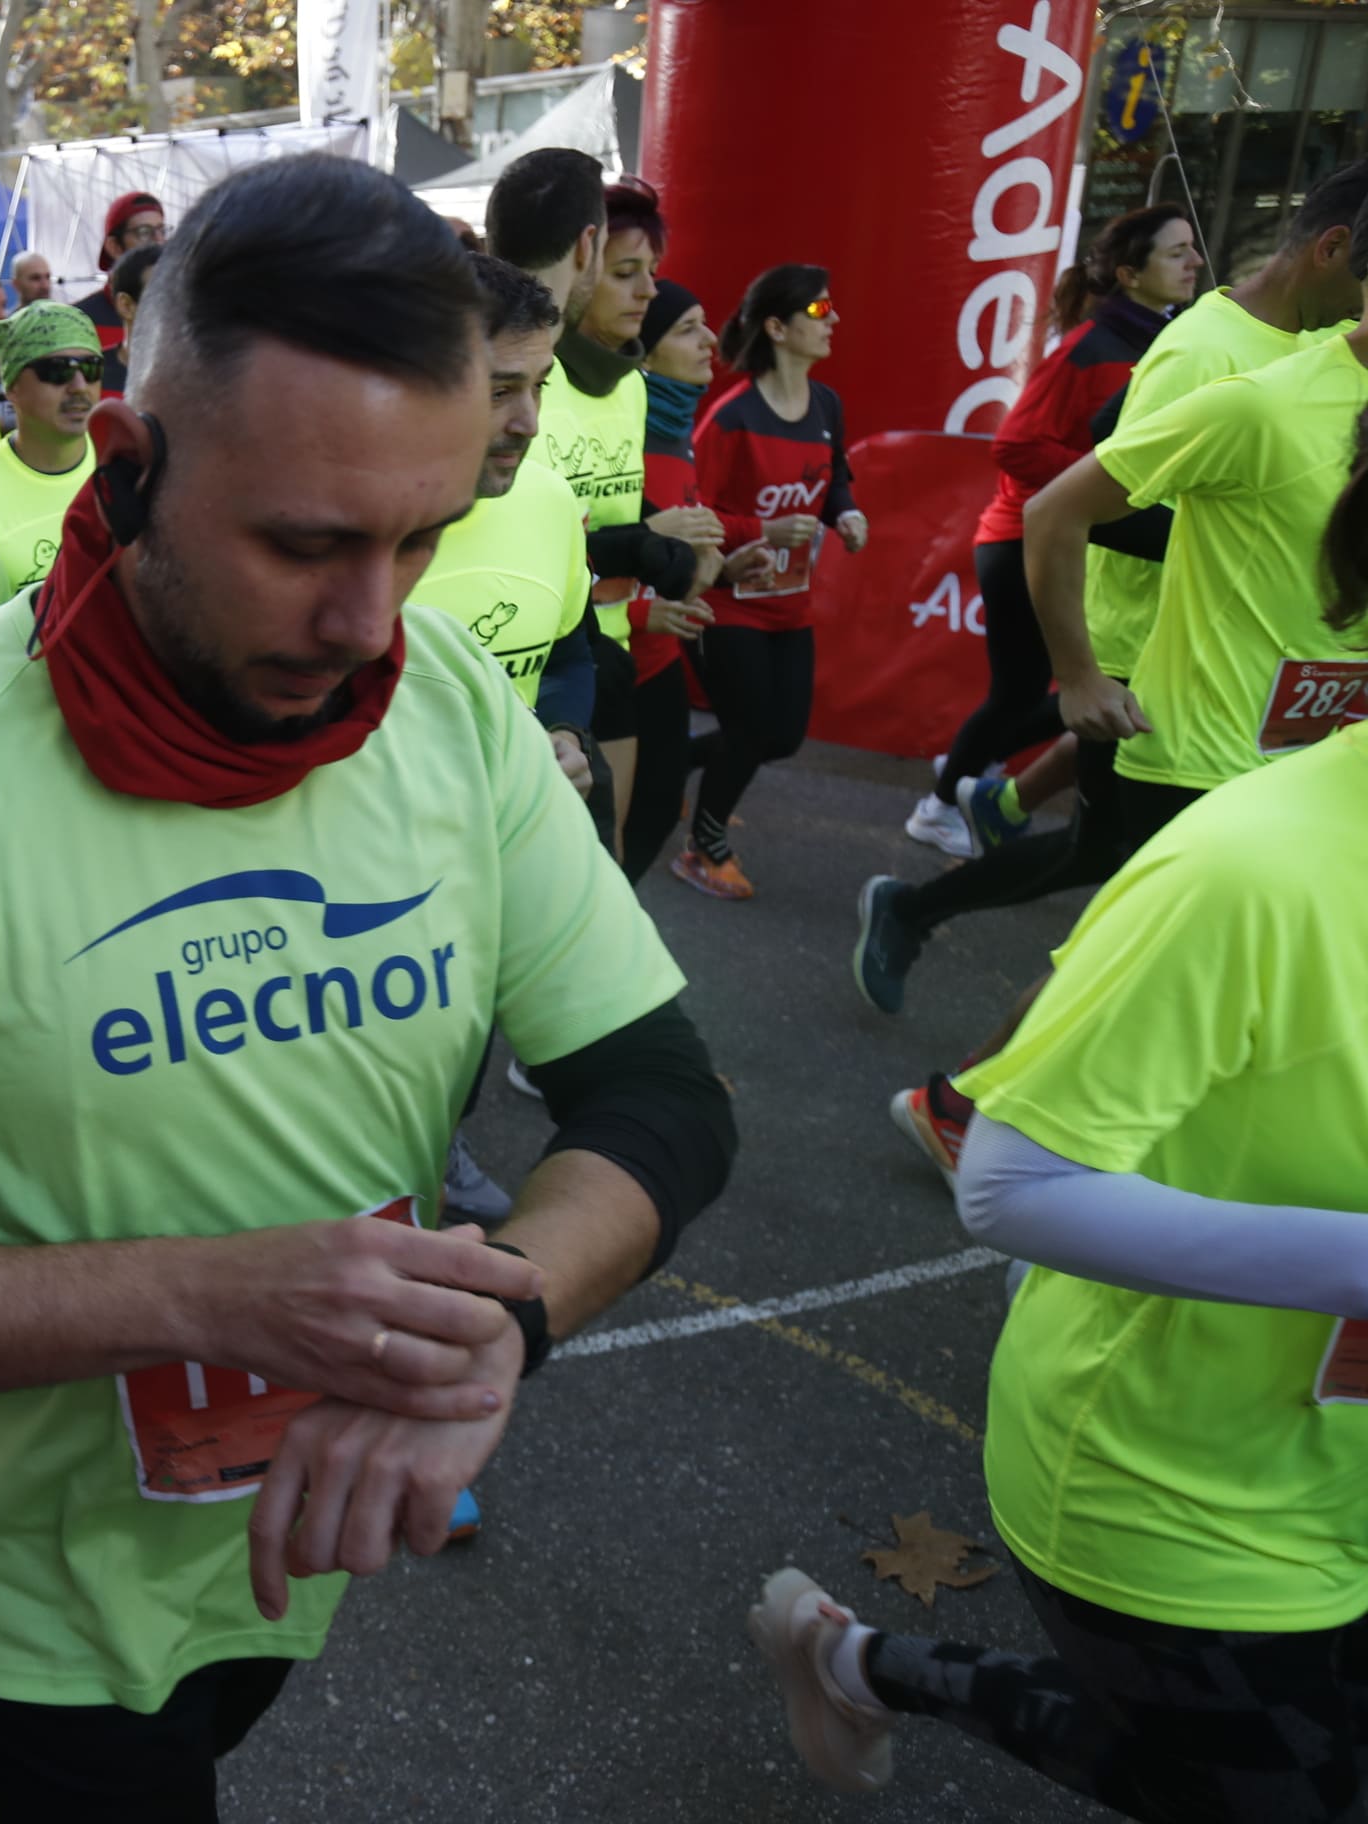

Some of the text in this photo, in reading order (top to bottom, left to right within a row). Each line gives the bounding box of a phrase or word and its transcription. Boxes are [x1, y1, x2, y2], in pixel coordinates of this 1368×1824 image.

[755, 480, 826, 518] gmv
[182, 926, 288, 975] grupo
[91, 942, 455, 1076] elecnor
